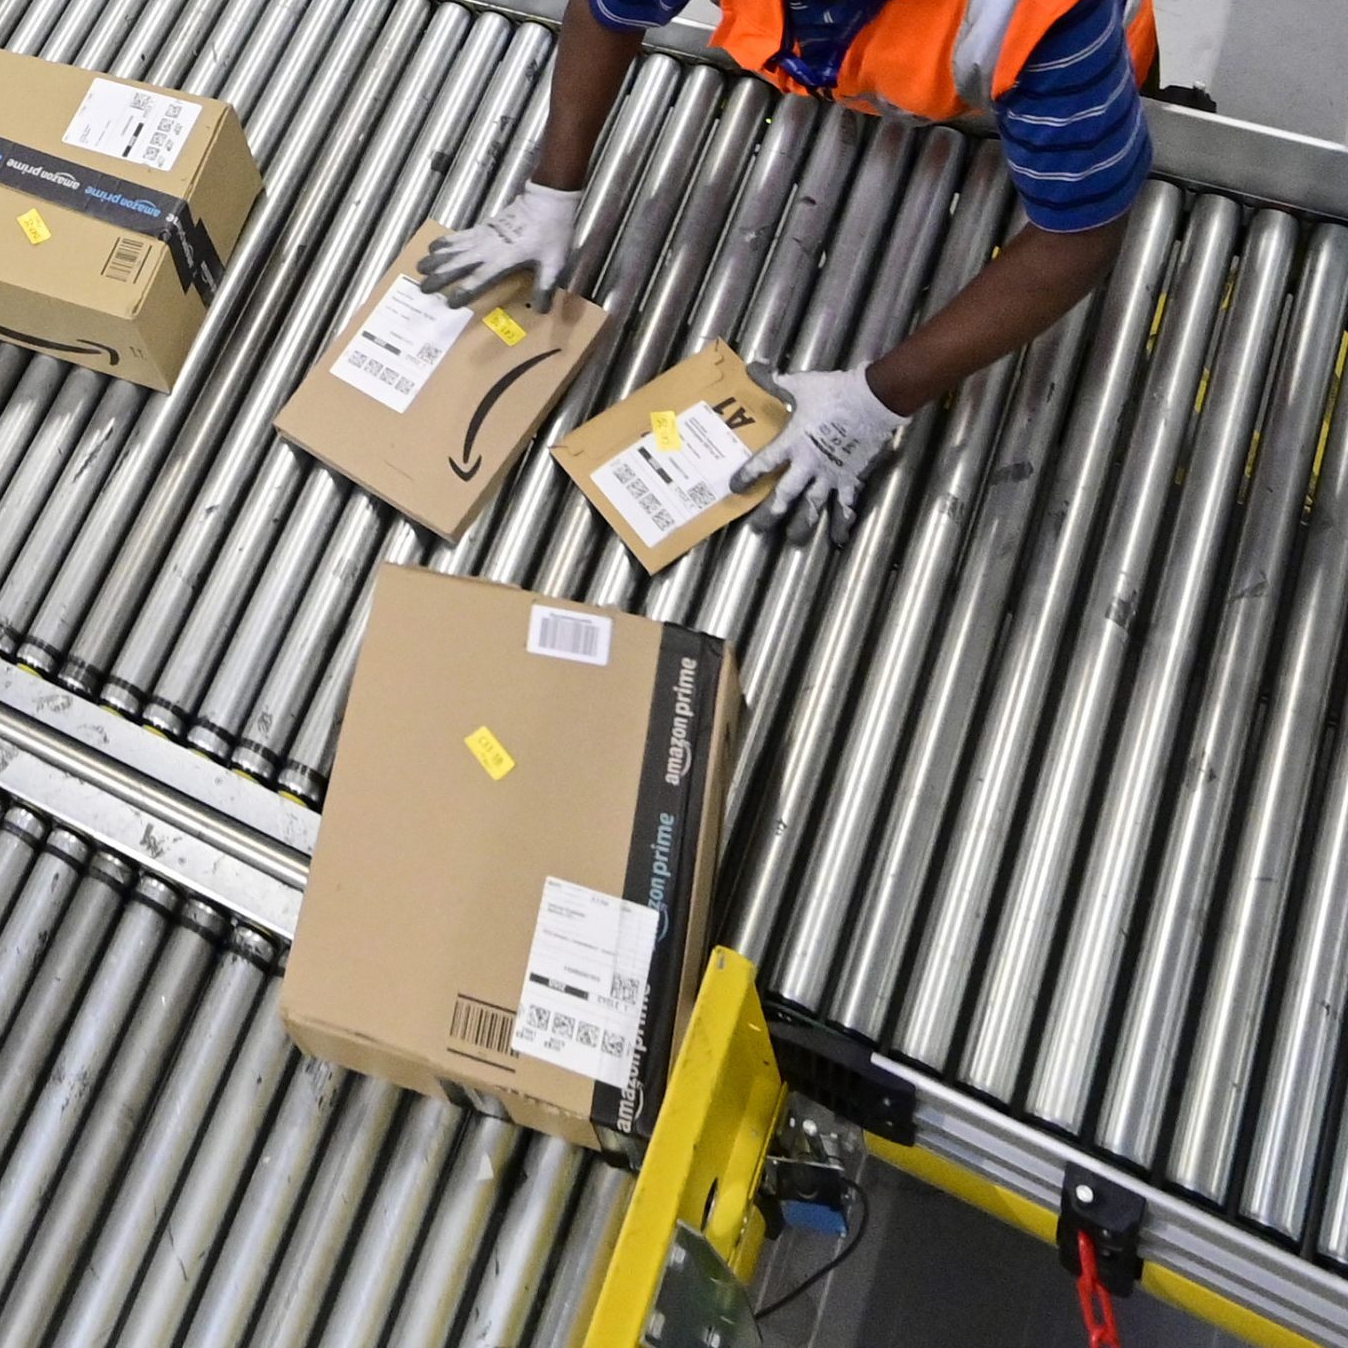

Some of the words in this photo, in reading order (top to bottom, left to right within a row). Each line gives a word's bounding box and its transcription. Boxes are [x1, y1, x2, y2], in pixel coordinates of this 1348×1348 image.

[5, 156, 42, 178] prime
[40, 170, 81, 190] amazon
[84, 184, 119, 205] prime
[116, 197, 162, 219] amazon
[712, 396, 757, 431] A1
[673, 657, 698, 718] prime
[665, 717, 692, 787] amazon
[651, 812, 675, 878] prime
